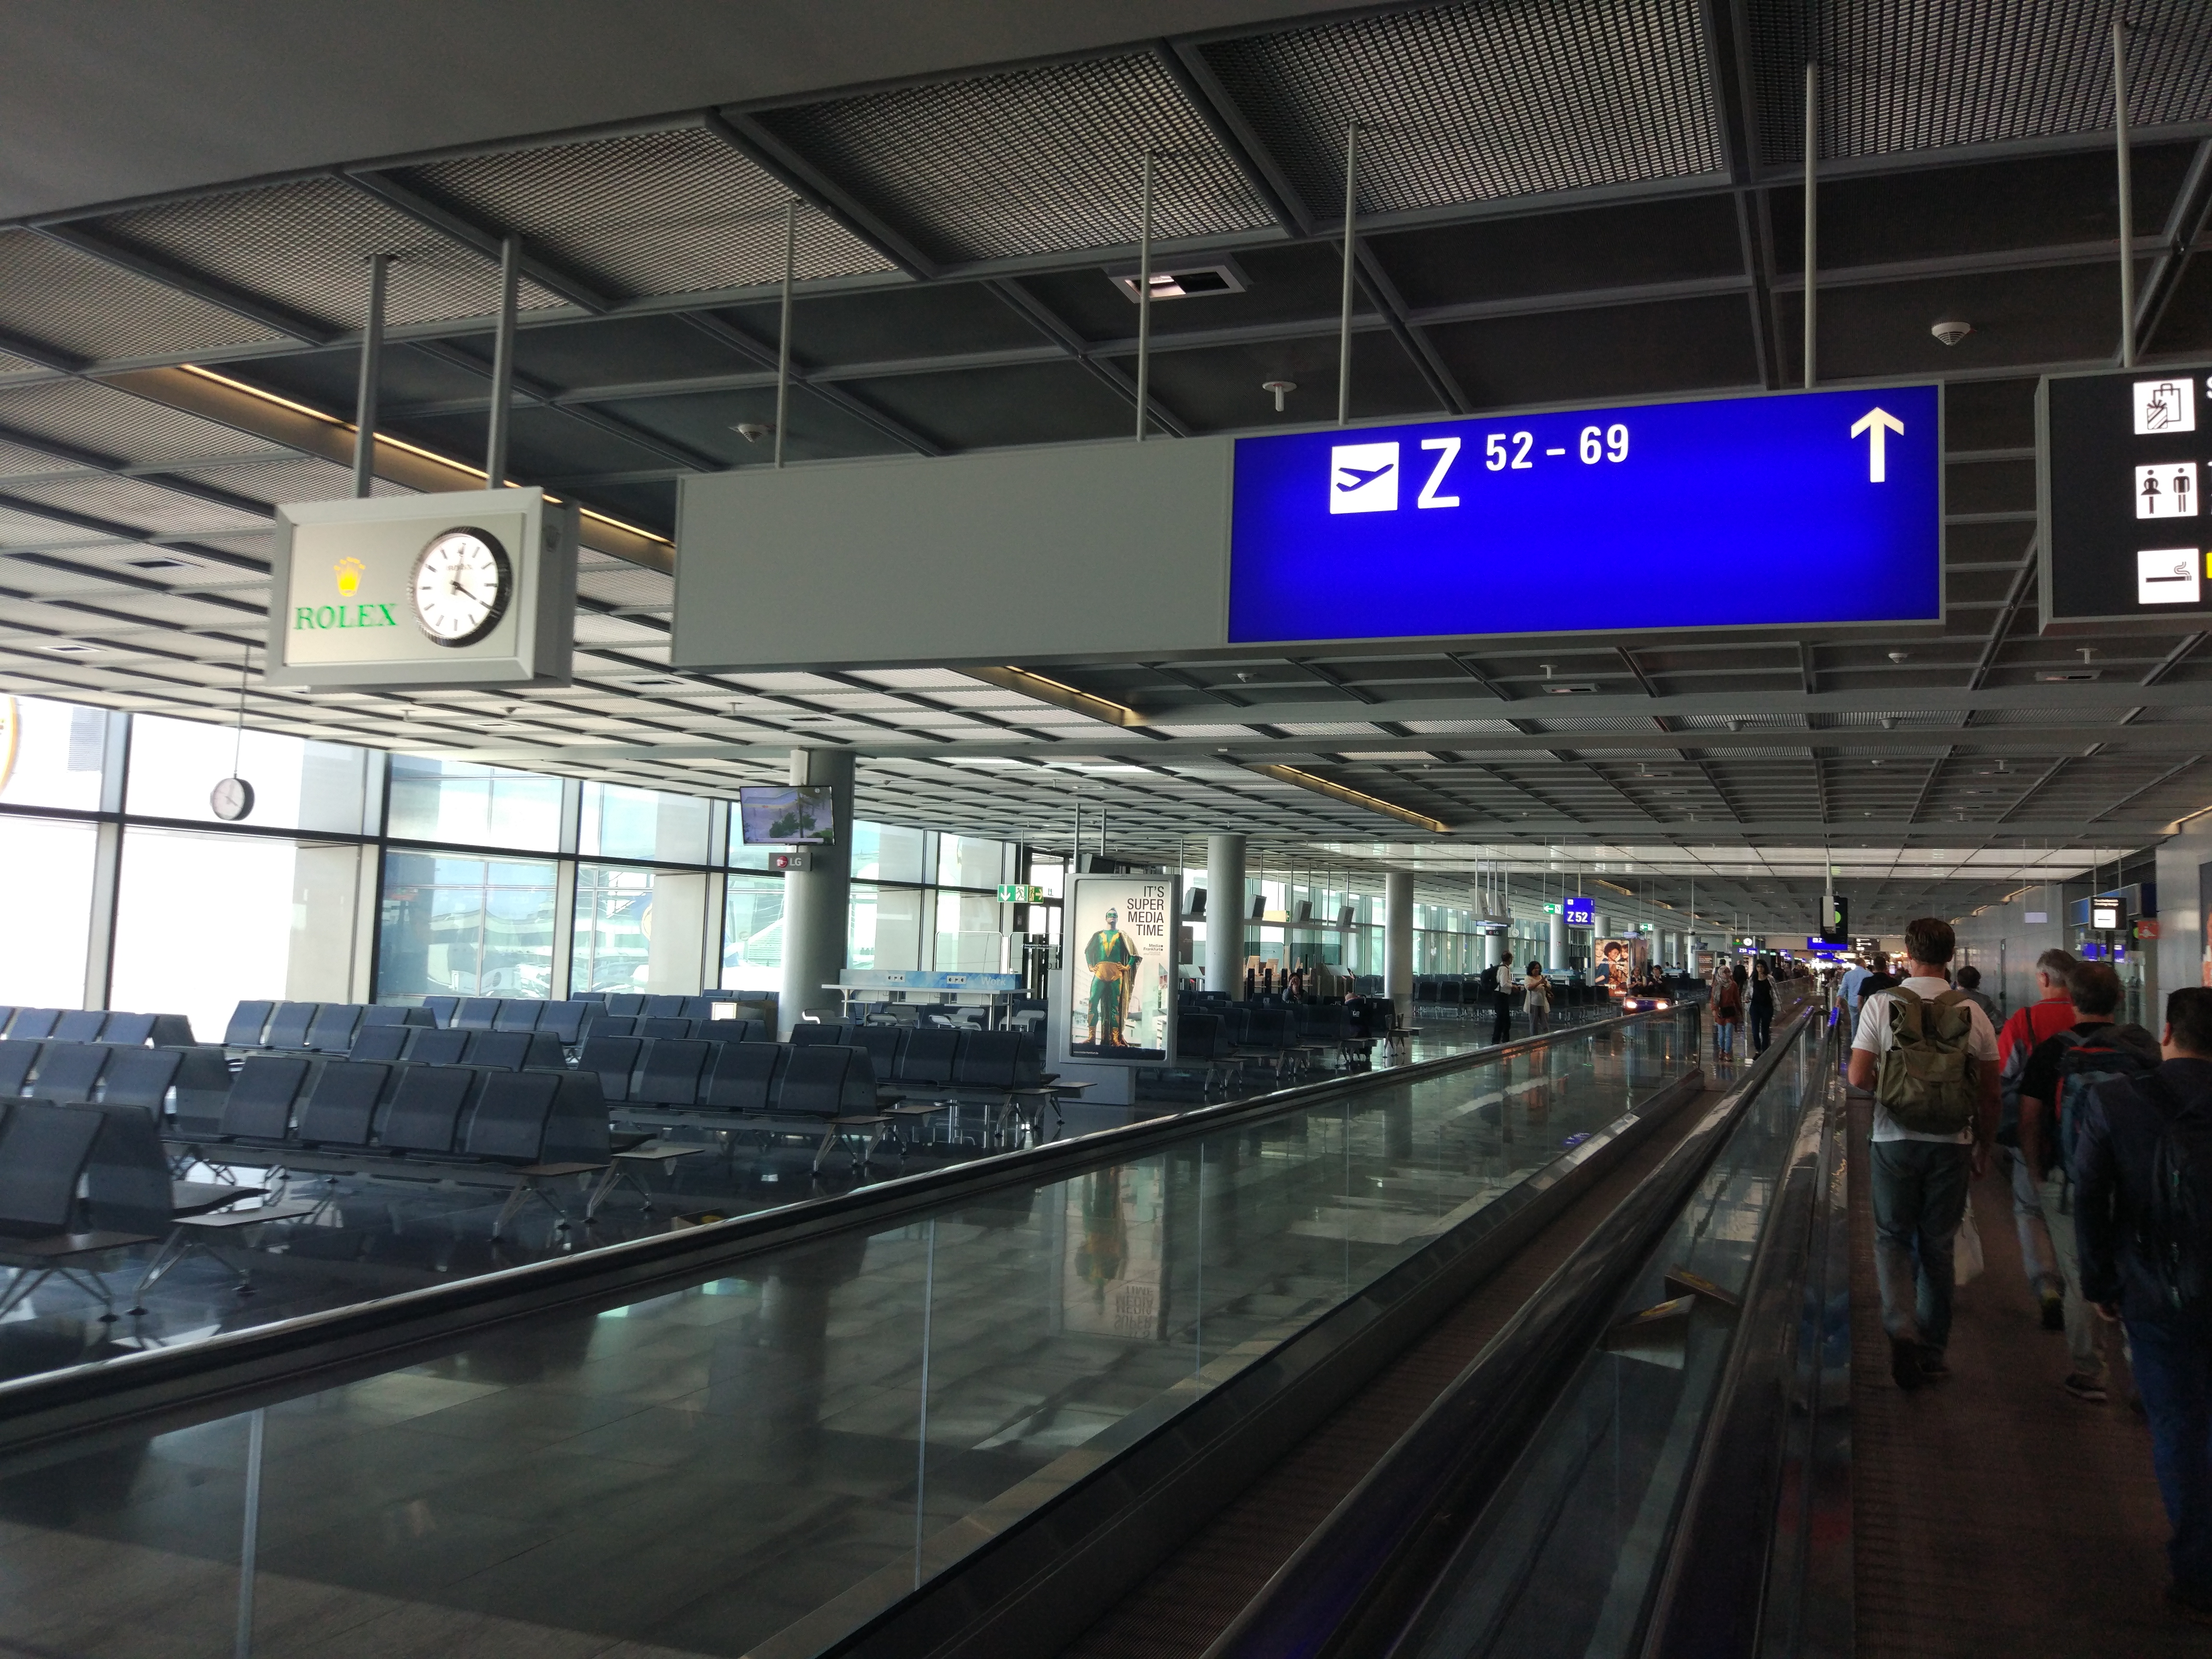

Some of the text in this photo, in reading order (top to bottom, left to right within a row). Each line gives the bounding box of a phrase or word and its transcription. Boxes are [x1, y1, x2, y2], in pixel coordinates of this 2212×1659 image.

[1418, 437, 1461, 509] Z
[1486, 431, 1533, 471] 52
[1579, 423, 1629, 465] 69
[293, 603, 397, 630] ROLEX
[789, 857, 802, 866] LG
[1144, 886, 1164, 898] IT'S
[1127, 898, 1164, 910] SUPER
[1128, 911, 1164, 923] MEDIA
[1136, 924, 1164, 936] TIME
[981, 976, 1006, 986] Work
